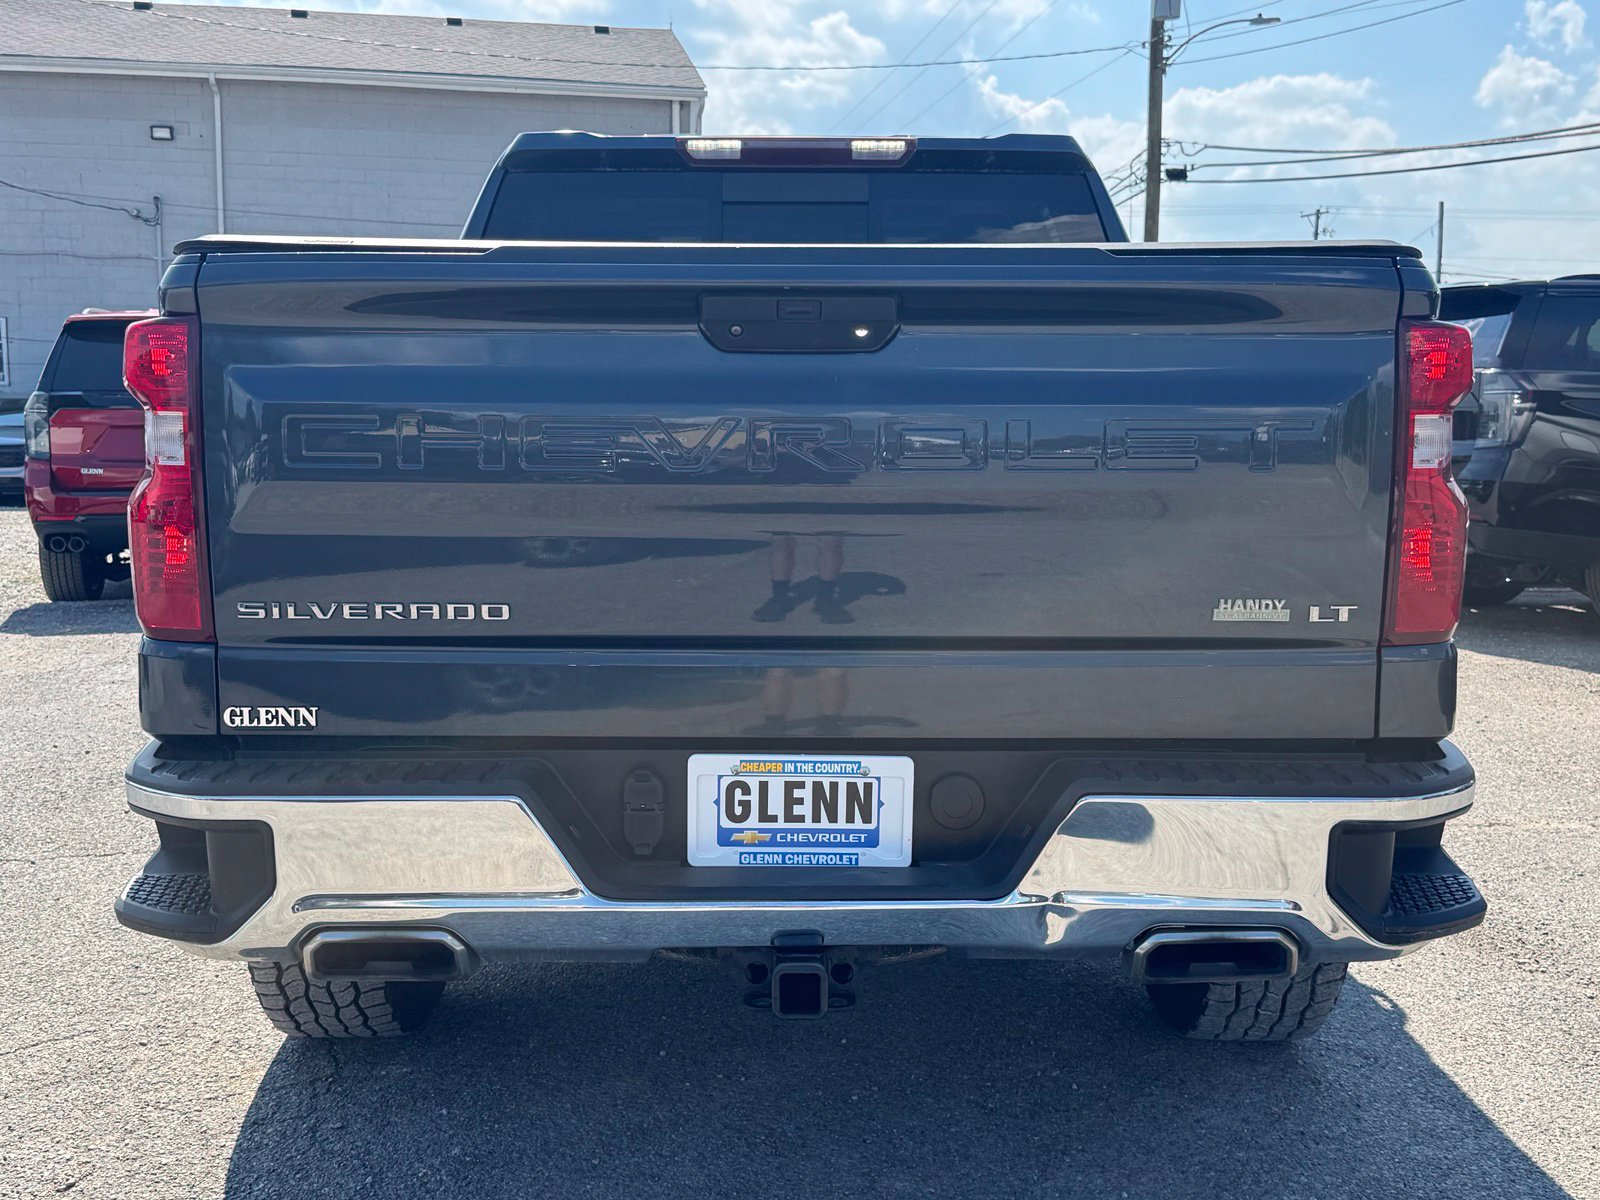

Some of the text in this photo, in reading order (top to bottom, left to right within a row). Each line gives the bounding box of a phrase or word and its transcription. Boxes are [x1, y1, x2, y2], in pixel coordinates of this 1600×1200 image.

[281, 413, 1315, 472] CHEVROLET
[80, 467, 104, 475] GLENN
[236, 602, 511, 620] SILVERADO
[1219, 599, 1286, 612] HANDY
[1309, 605, 1358, 622] LT
[222, 706, 319, 727] GLENN
[740, 761, 861, 774] CHEAPER IN THE COUNTRY.
[725, 780, 873, 824] GLENN
[776, 832, 868, 843] CHEVROLET
[740, 853, 858, 865] GLENN CHEVROLET
